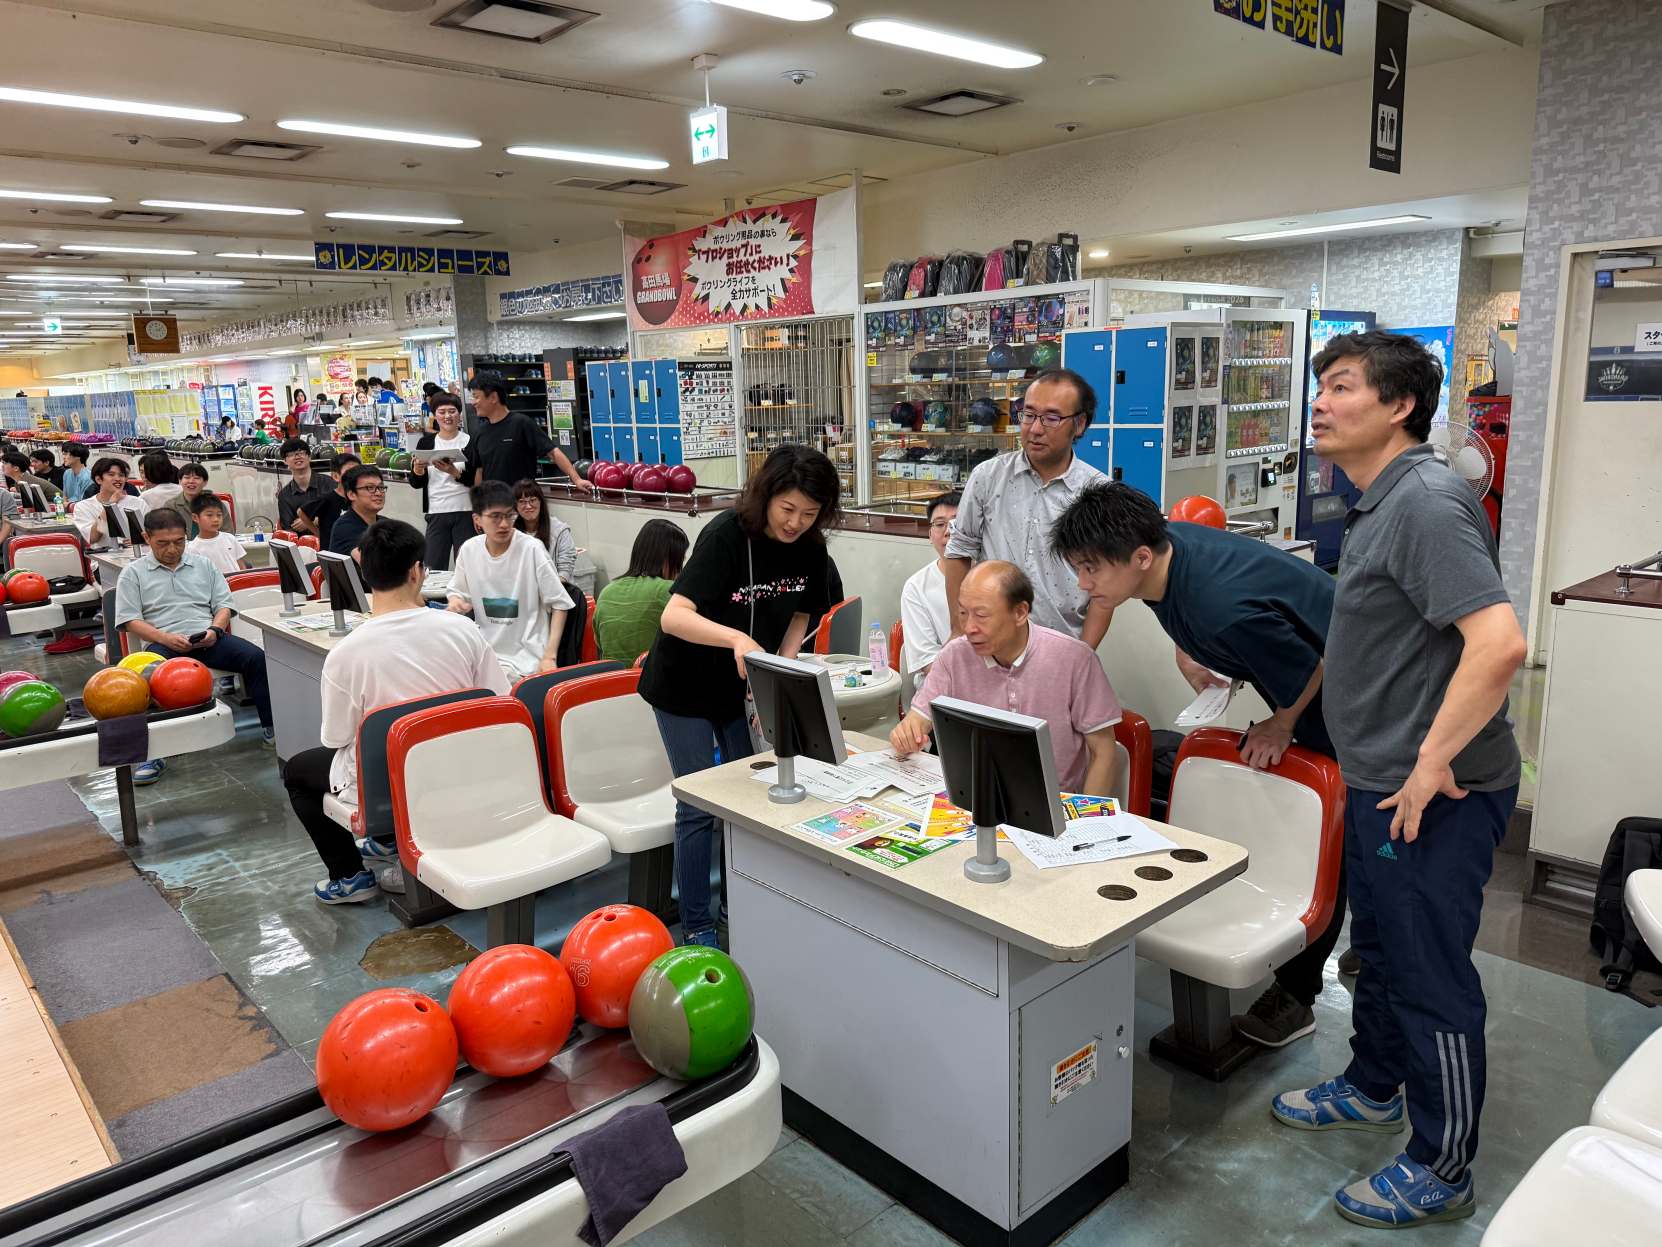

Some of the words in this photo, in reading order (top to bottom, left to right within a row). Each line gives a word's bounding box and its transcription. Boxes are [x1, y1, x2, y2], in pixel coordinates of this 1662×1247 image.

[713, 228, 777, 245] ボウリング用品の事なら
[697, 240, 762, 264] 「プロショップ」に
[339, 248, 493, 275] レンタルシューズ
[701, 275, 757, 292] ボウリングライフを
[637, 287, 677, 304] GRANDBOWL
[1644, 331, 1662, 340] スタ
